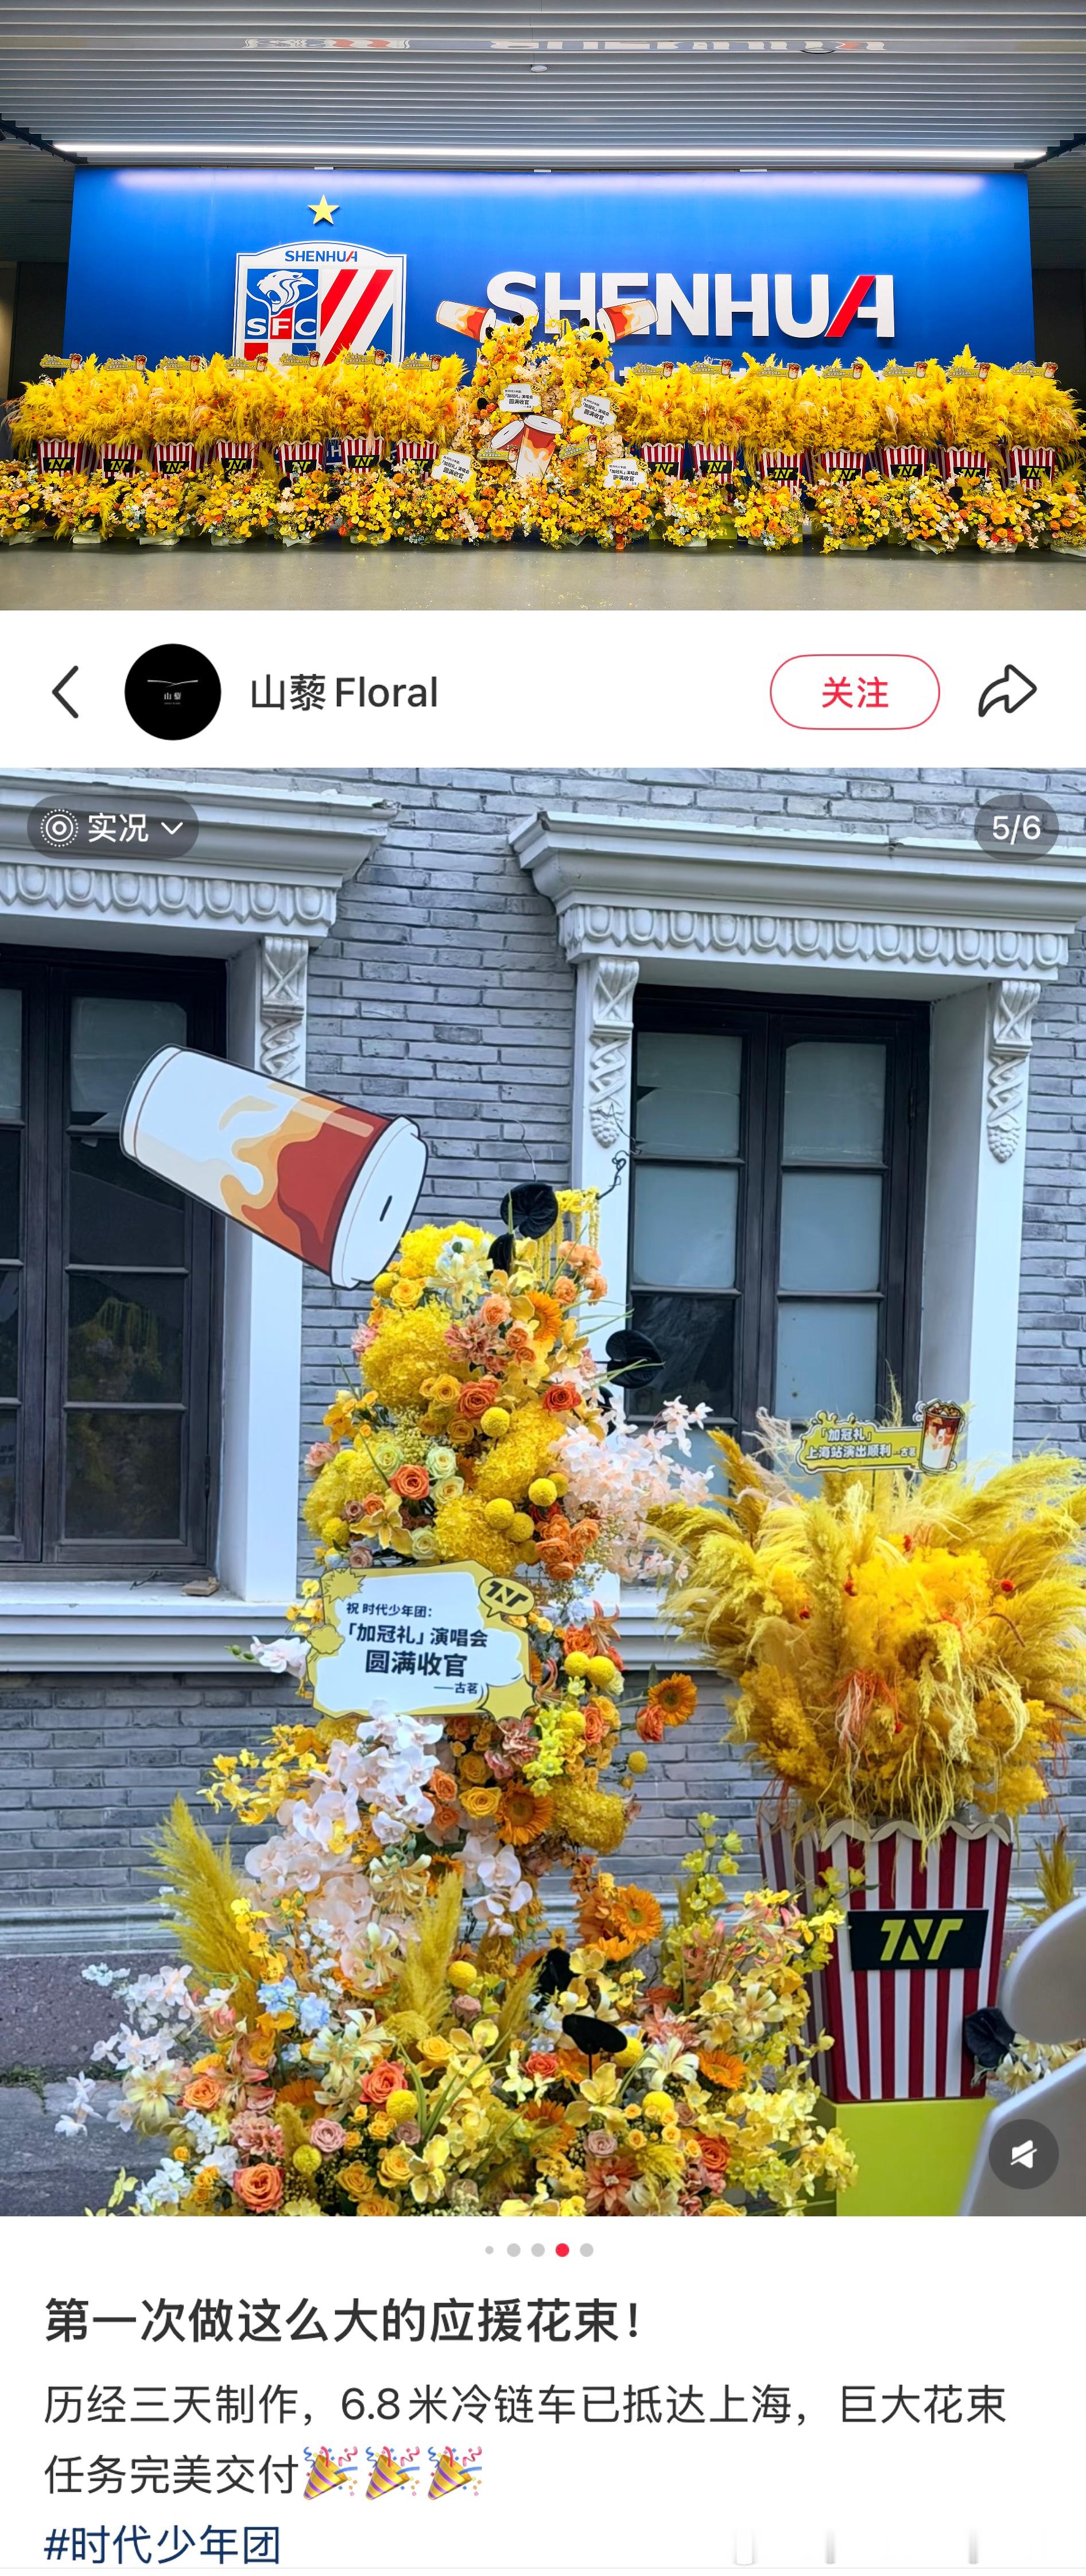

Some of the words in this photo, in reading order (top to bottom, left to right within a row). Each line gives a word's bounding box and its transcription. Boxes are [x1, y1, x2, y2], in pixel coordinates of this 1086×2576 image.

[285, 250, 358, 262] SHENHUA
[486, 271, 895, 338] SHENHUA
[247, 318, 316, 336] SFC
[486, 1580, 529, 1608] TNT
[365, 1649, 468, 1677] 圆满收官
[880, 1919, 964, 1961] TNT
